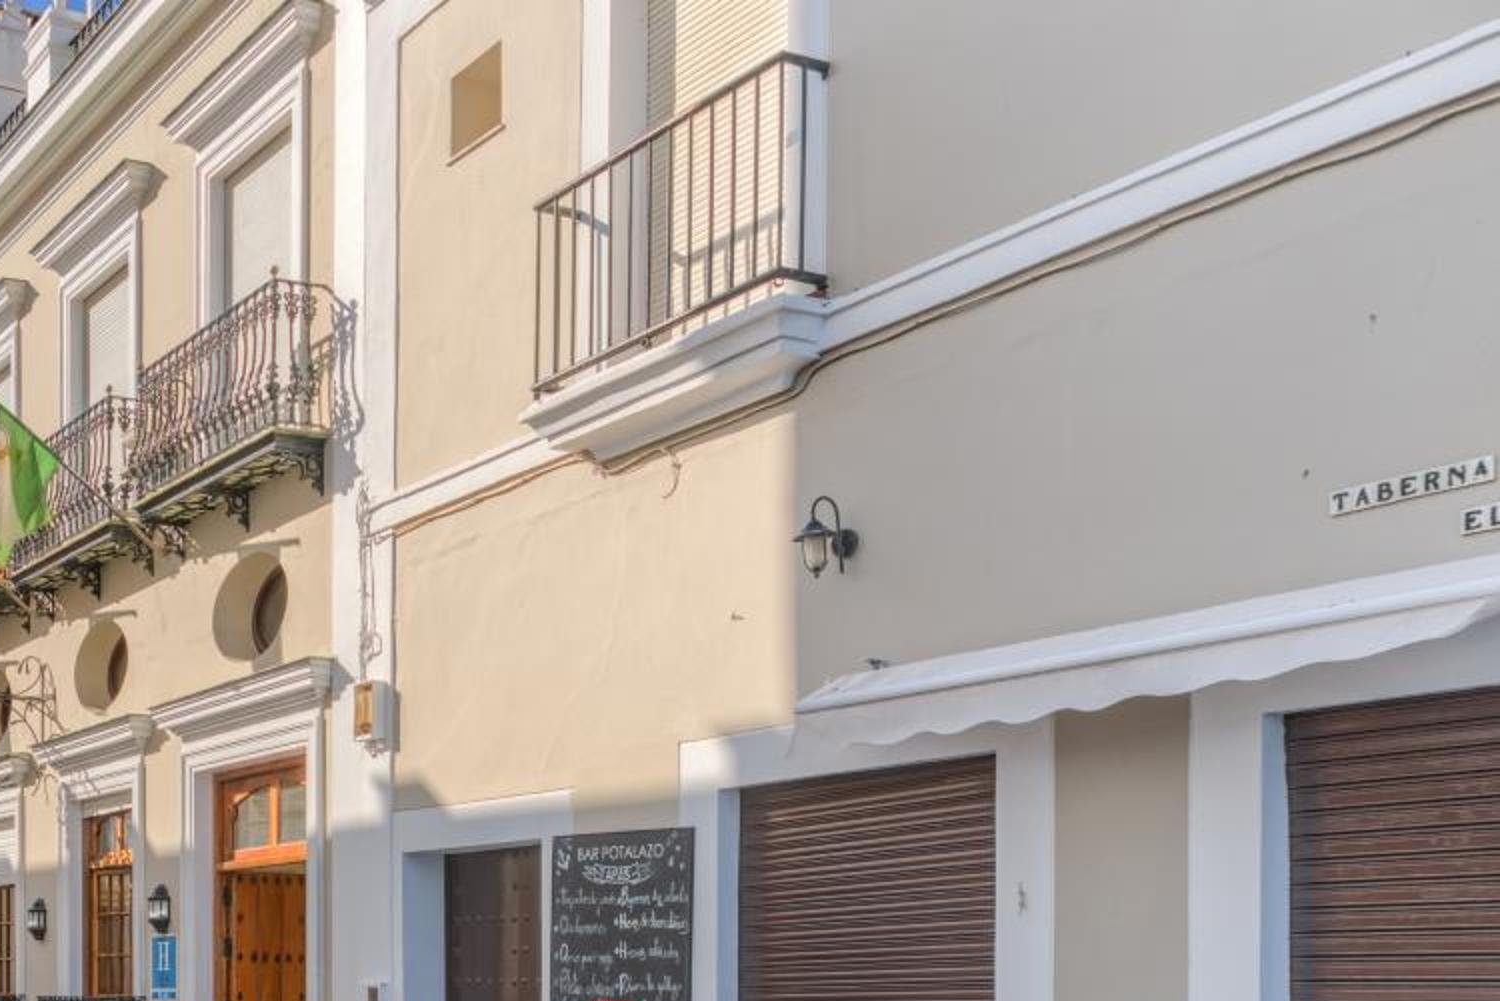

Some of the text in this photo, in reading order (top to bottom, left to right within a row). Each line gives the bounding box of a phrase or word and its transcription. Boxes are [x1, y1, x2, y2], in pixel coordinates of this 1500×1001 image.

[1332, 459, 1489, 512] TABERNA
[1464, 505, 1500, 531] EL
[577, 843, 665, 862] BAR POTALAZO
